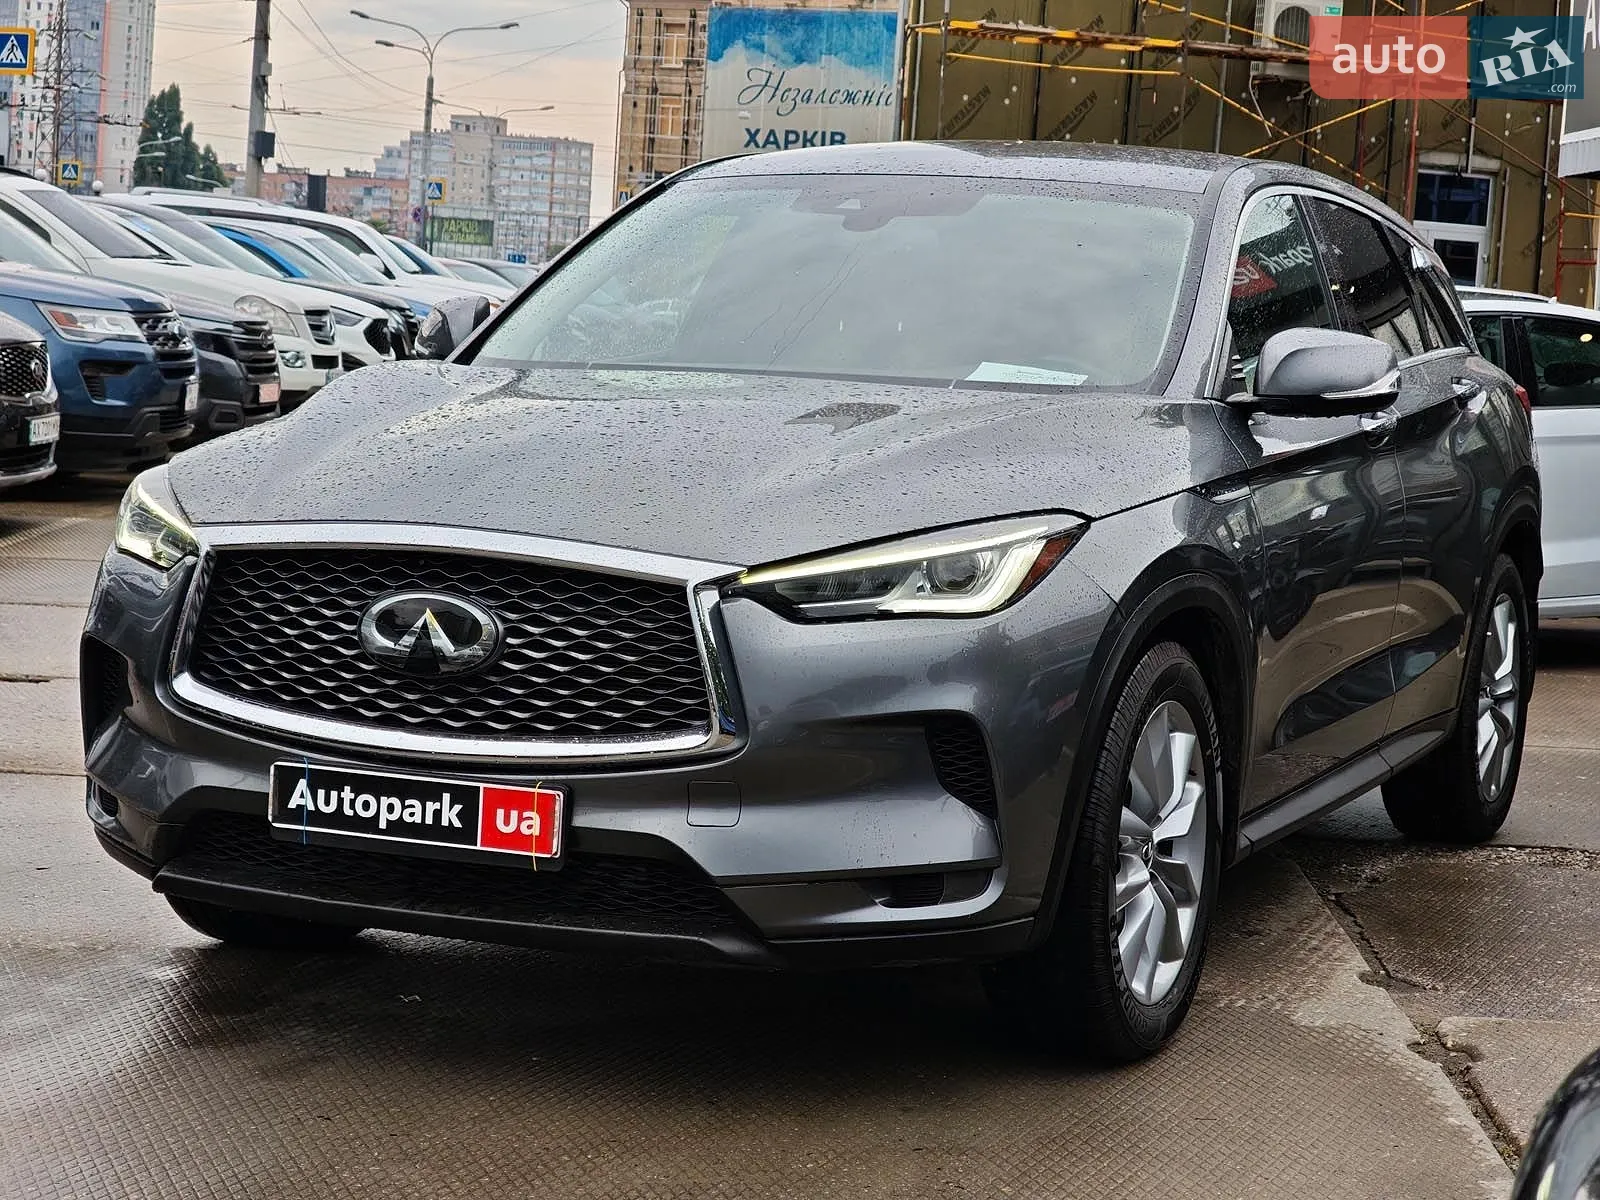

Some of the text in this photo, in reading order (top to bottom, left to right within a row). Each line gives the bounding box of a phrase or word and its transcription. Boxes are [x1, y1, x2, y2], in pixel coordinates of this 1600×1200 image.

[743, 127, 847, 151] ХАРКІВ
[287, 778, 542, 836] Autopark ua
